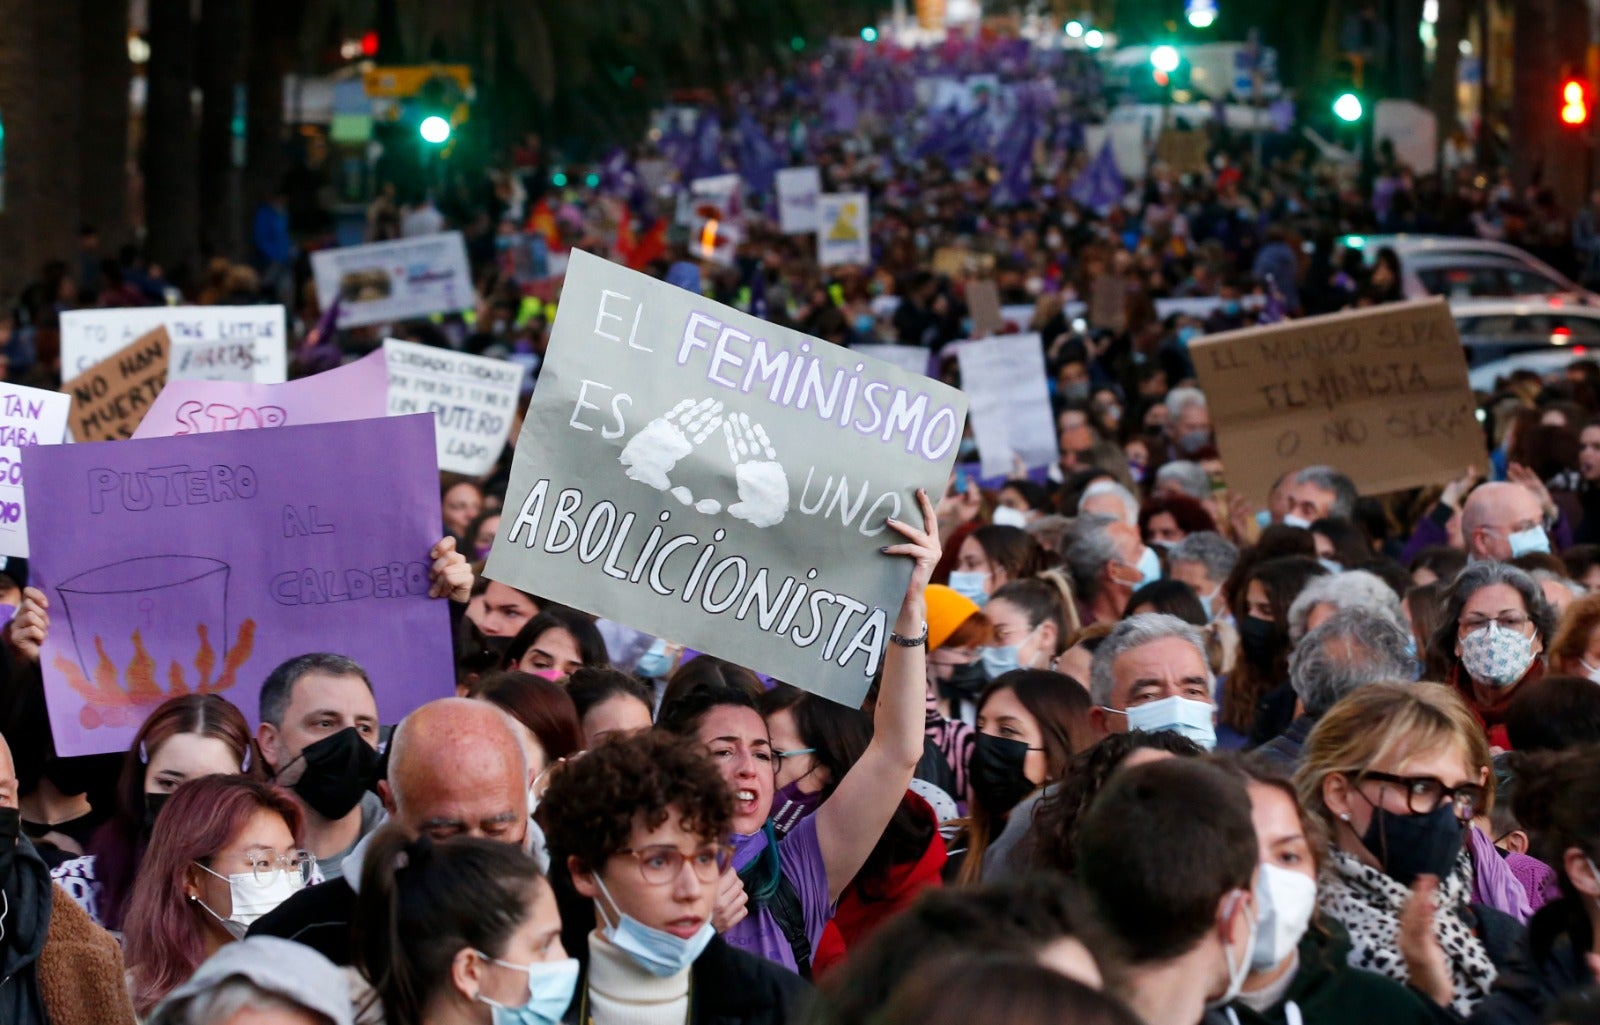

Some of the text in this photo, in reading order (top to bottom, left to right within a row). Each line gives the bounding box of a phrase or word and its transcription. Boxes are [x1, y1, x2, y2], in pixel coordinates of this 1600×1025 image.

[74, 375, 109, 409] NO
[119, 341, 164, 378] HAN
[594, 289, 653, 352] EL
[675, 310, 960, 462] FEMINISMO
[1209, 346, 1249, 371] EL
[3, 394, 45, 420] TAN
[428, 401, 504, 436] PUTERO
[569, 379, 902, 538] ES UNO
[1276, 430, 1301, 458] O
[1323, 417, 1368, 446] NO
[87, 464, 258, 514] PUTERO
[282, 504, 335, 538] AL
[270, 561, 430, 606] CALDERO
[507, 478, 888, 678] ABOLICIONISTA
